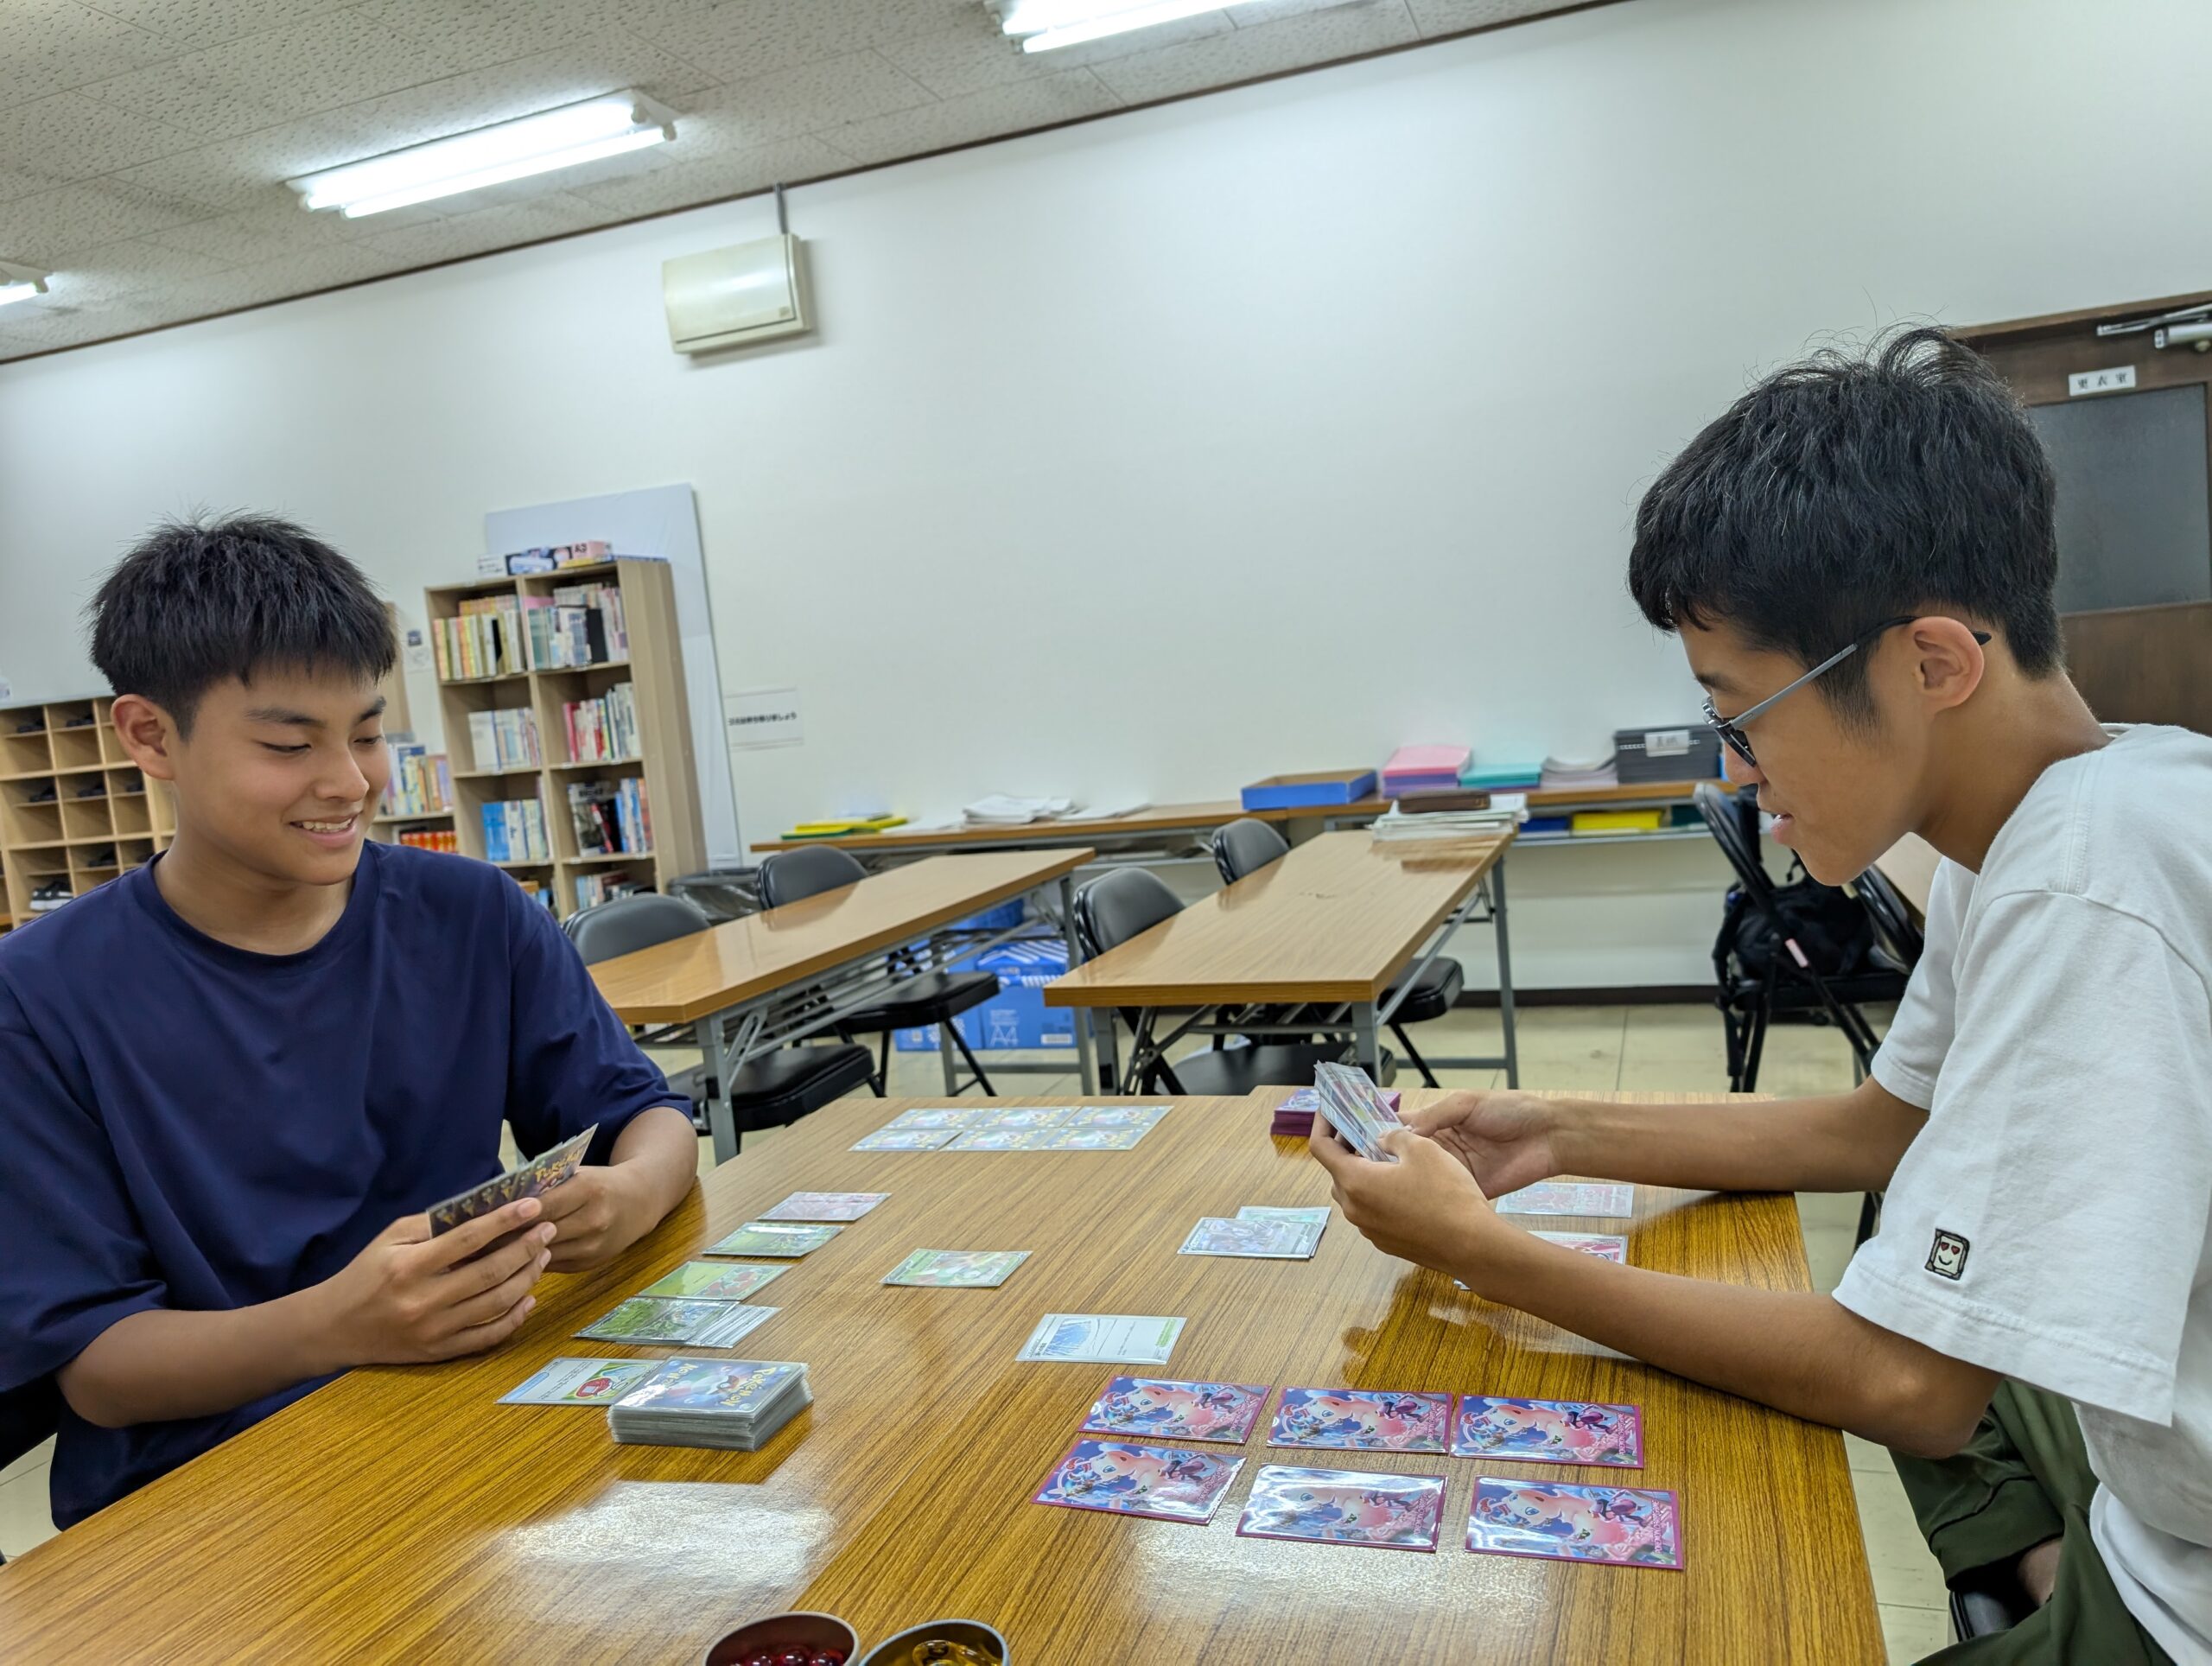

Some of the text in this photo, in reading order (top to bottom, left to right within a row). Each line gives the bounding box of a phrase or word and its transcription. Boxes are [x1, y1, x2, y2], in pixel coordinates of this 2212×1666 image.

[2077, 372, 2127, 389] 更衣室
[989, 1025, 1018, 1046] A4
